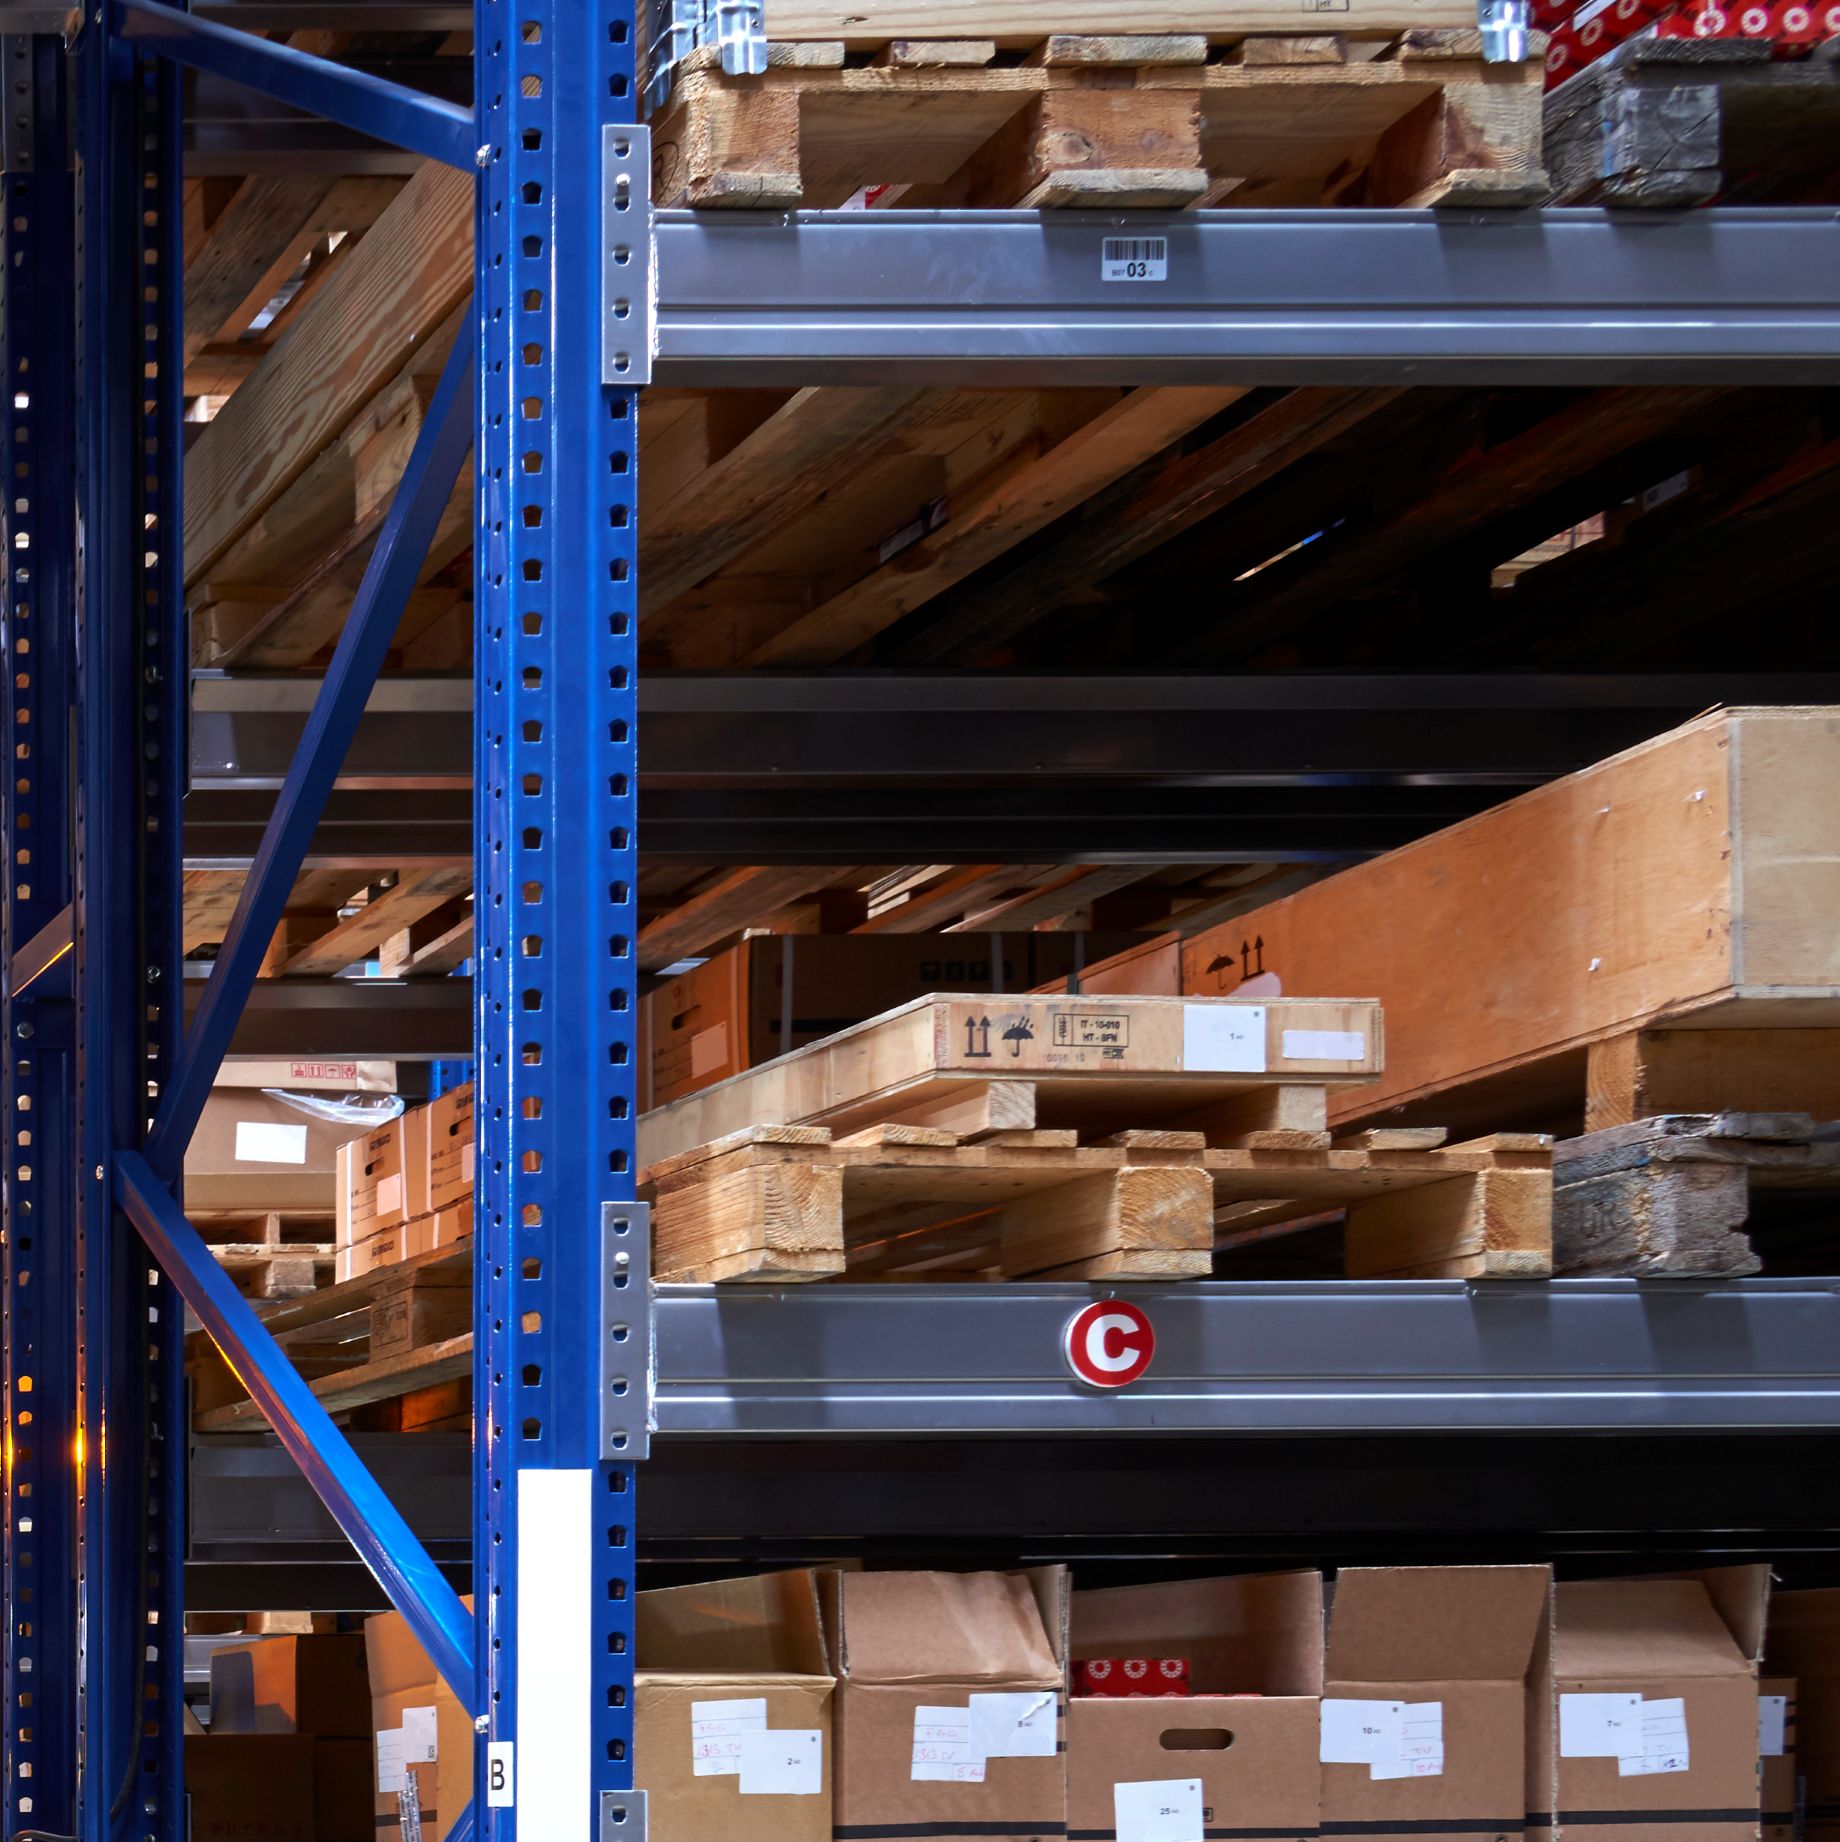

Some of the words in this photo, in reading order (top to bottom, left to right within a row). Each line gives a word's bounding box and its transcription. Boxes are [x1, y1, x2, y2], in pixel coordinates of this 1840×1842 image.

[1127, 262, 1146, 277] 03
[1086, 1314, 1140, 1372] C
[1363, 1727, 1372, 1735] 10
[491, 1760, 506, 1791] B
[1160, 1807, 1170, 1816] 25
